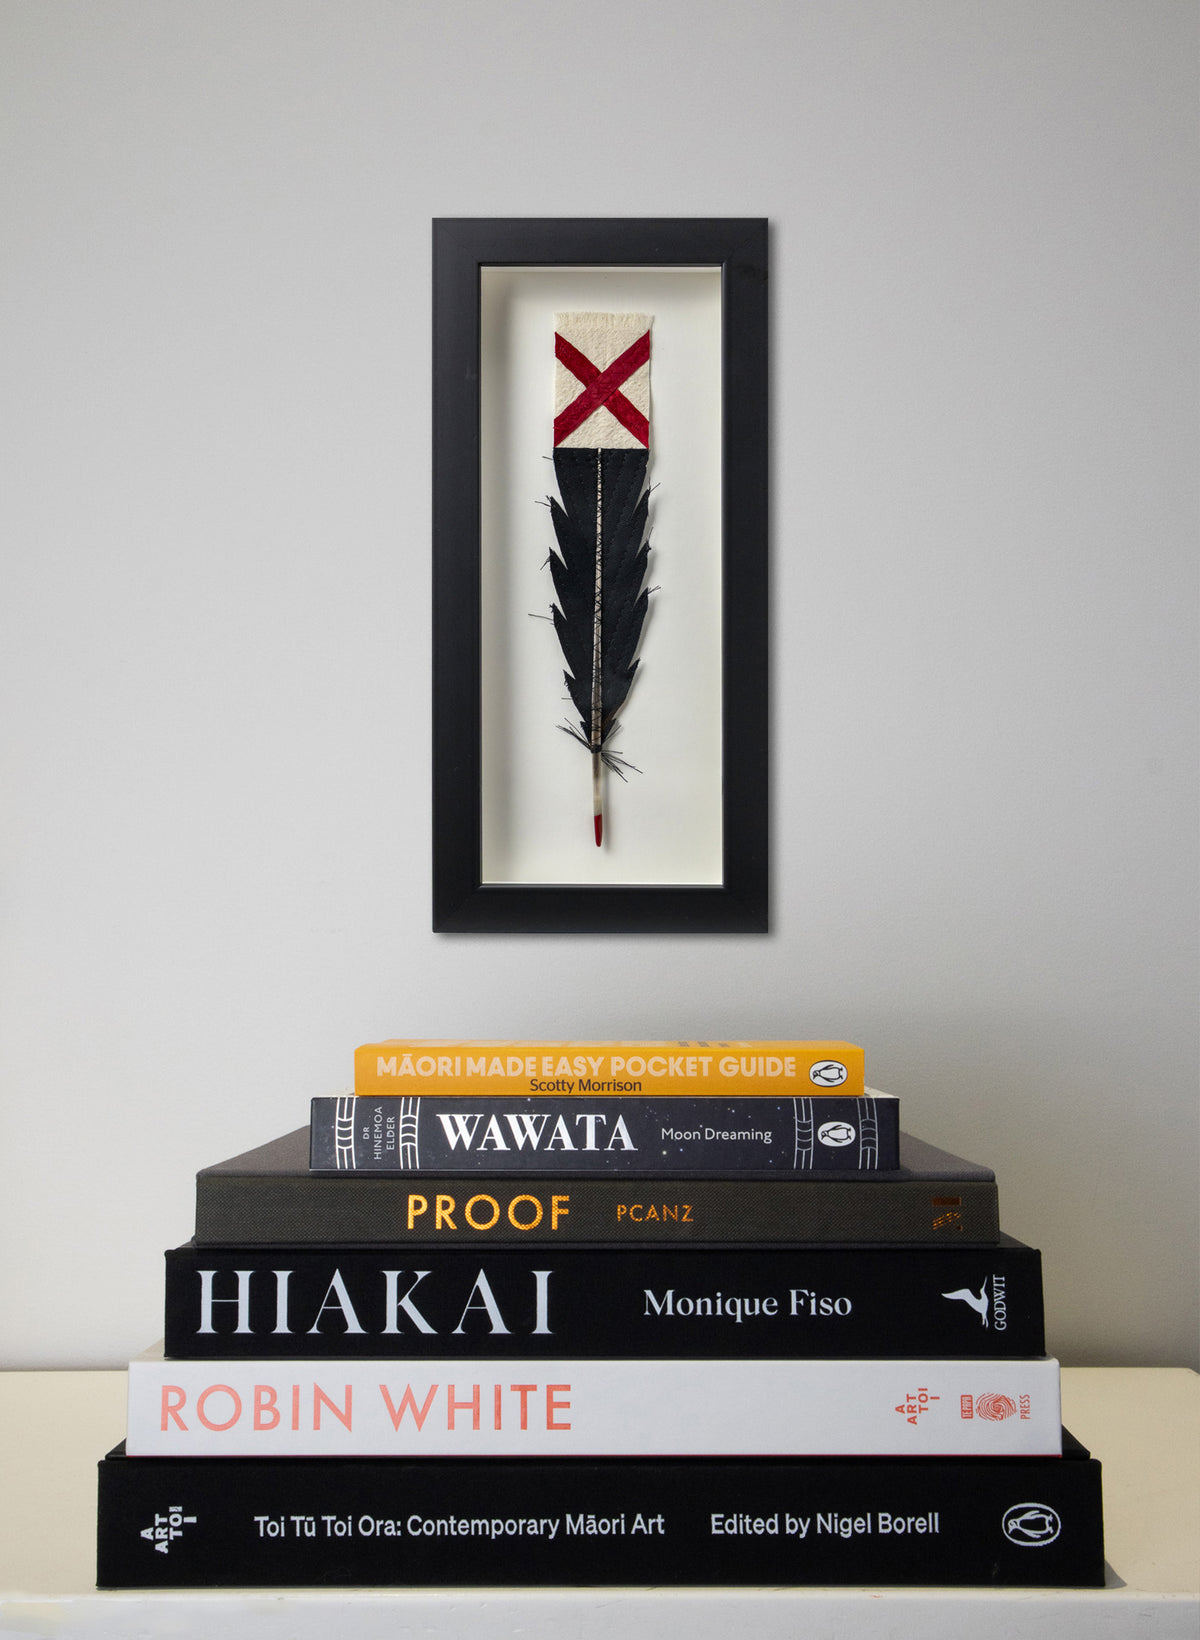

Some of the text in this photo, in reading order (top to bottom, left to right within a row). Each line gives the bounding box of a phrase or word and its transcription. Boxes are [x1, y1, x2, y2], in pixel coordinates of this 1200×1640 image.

[377, 1054, 795, 1077] MĀORI MADE EASY POCKET GUIDE
[529, 1078, 642, 1094] Scotty Morrison
[362, 1126, 370, 1140] DR
[373, 1105, 383, 1160] HINEMOA
[386, 1115, 396, 1151] ELDER
[436, 1114, 638, 1150] WAWATA
[661, 1128, 772, 1144] Moon Dreaming
[408, 1195, 569, 1230] PROOF
[617, 1205, 693, 1222] PCANZ
[197, 1269, 552, 1334] HIAKAI
[644, 1290, 851, 1322] Monique Fiso
[993, 1275, 1006, 1330] GODWIT
[161, 1383, 571, 1432] ROBIN WHITE
[1019, 1395, 1030, 1419] PRESS
[254, 1514, 664, 1539] Toi Tū Toi Ora: Contemporary Māori Art
[711, 1513, 939, 1538] Edited by Nigel Borell
